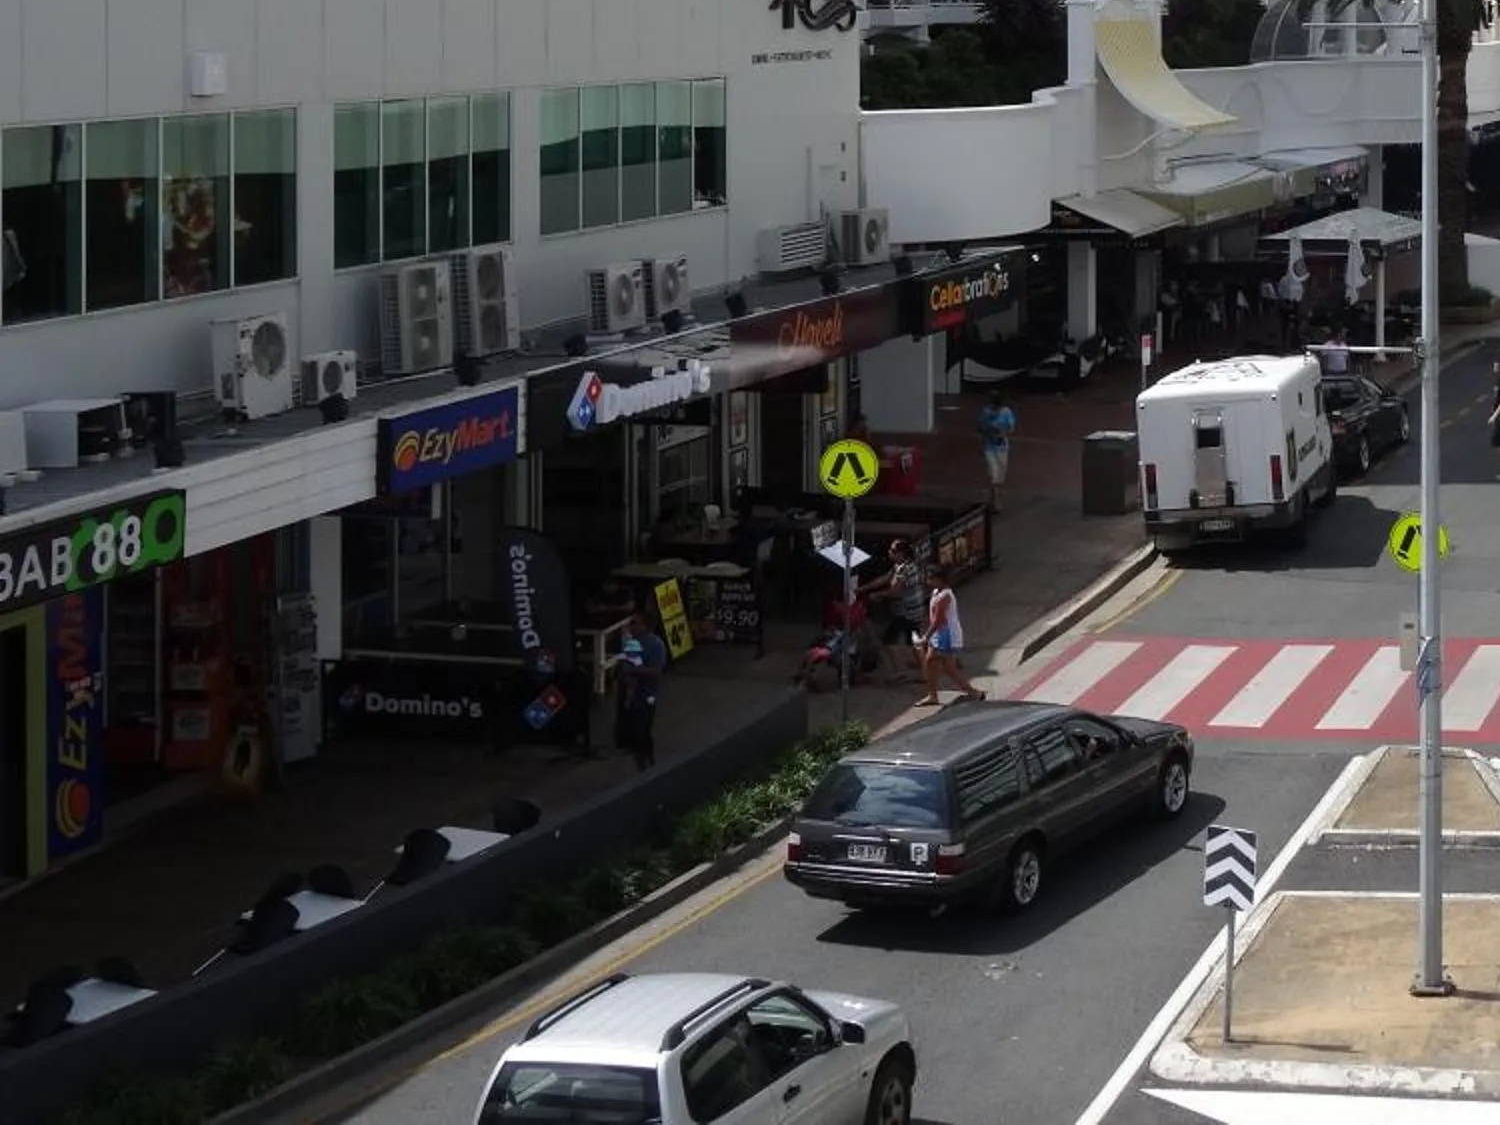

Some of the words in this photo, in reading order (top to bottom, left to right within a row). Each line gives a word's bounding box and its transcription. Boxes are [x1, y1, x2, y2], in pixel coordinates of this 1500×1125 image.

[592, 358, 711, 424] Domino's
[417, 409, 511, 467] EzyMart
[91, 515, 142, 574] 88
[364, 691, 483, 718] Domino's
